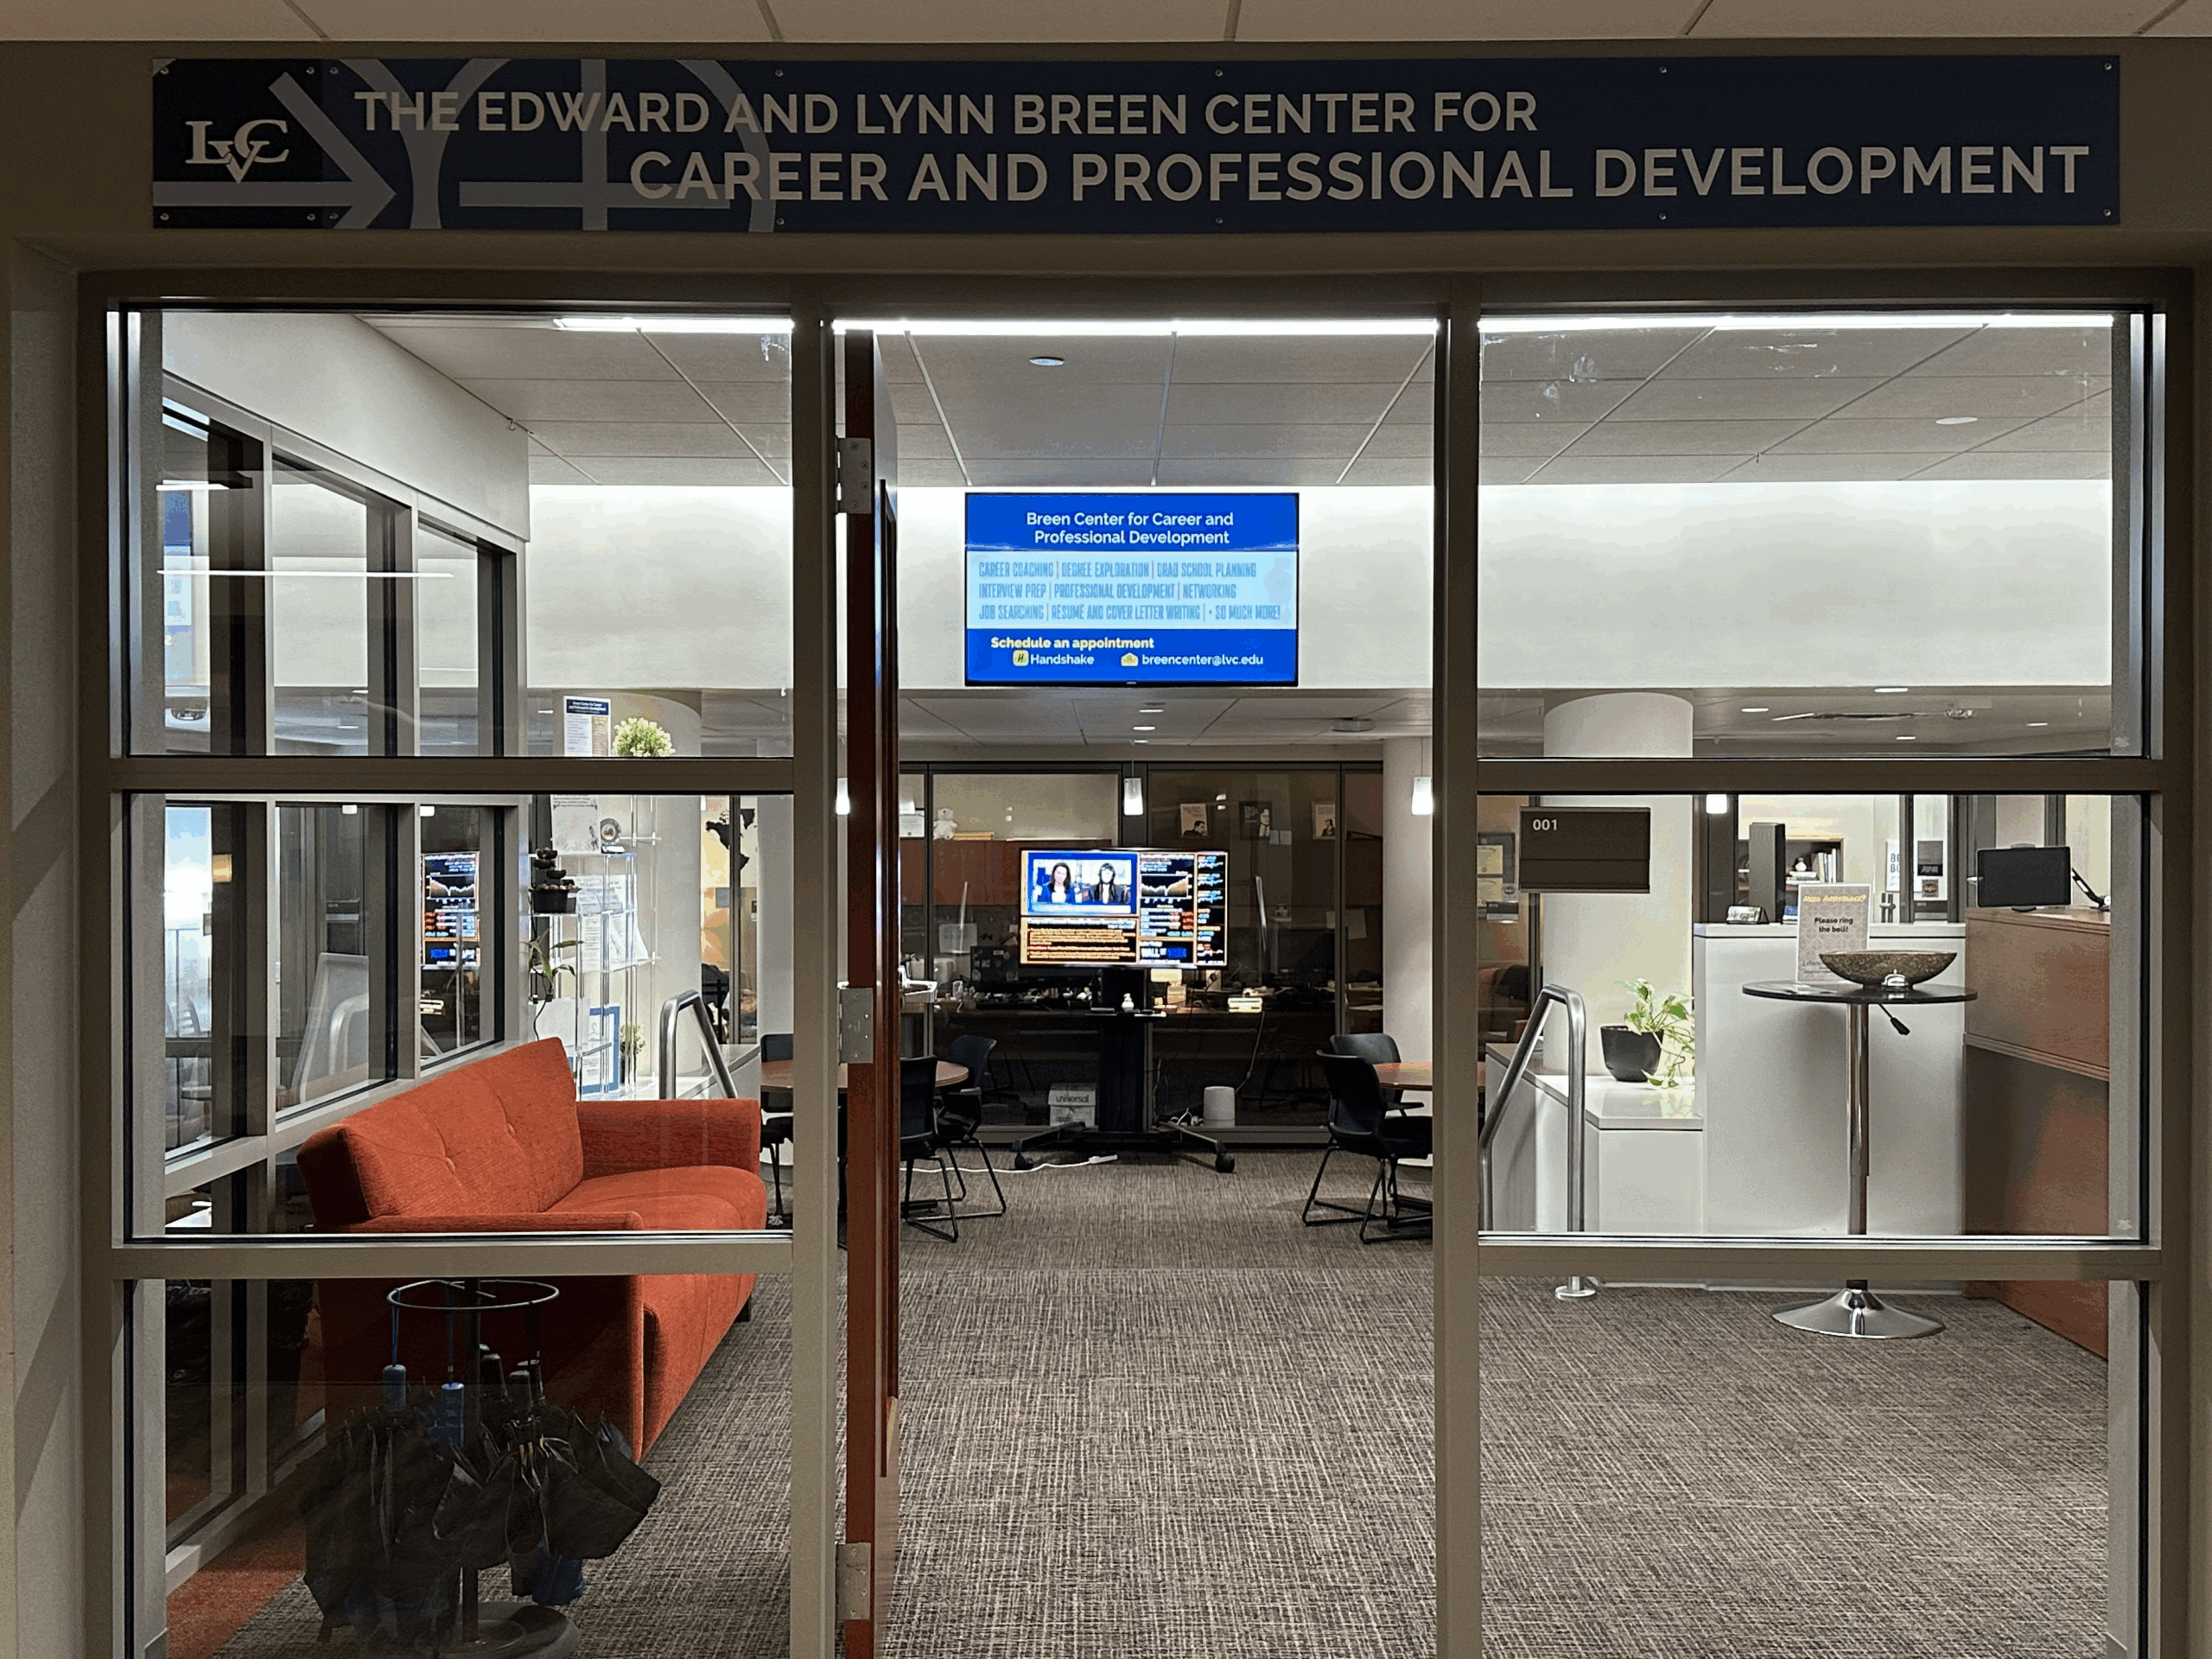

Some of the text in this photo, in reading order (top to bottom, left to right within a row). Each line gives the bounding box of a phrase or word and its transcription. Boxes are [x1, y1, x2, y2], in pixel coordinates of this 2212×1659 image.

[354, 91, 1538, 135] THE EDWARD AND LYNN BREEN CENTER FOR
[630, 145, 2090, 202] CAREER AND PROFESSIONAL DEVELOPMENT
[1026, 512, 1234, 526] Breen Center for Career and
[1034, 529, 1230, 547] Professional Development
[979, 562, 1256, 577] CAREER COACHING DEGREE EXPLORATION GRAD SCHOOL PLANNING
[979, 583, 1236, 598] INTERVIEW PREP PROFESSIONAL DEVELOPMENT NETWORKING
[979, 604, 995, 620] JOB
[998, 604, 1044, 620] SEARCHING
[1087, 604, 1103, 620] AND
[1106, 604, 1133, 620] COVER
[1135, 605, 1164, 620] LETTER
[1166, 605, 1200, 620] WRITING
[1215, 605, 1226, 620] SO
[1229, 605, 1252, 620] MUCH
[1255, 605, 1281, 620] MORE!
[990, 637, 1154, 652] Schedule an appointment
[1030, 653, 1095, 666] Handshake
[1141, 653, 1264, 666] breencenter@lvc.edu
[1532, 818, 1558, 831] 001
